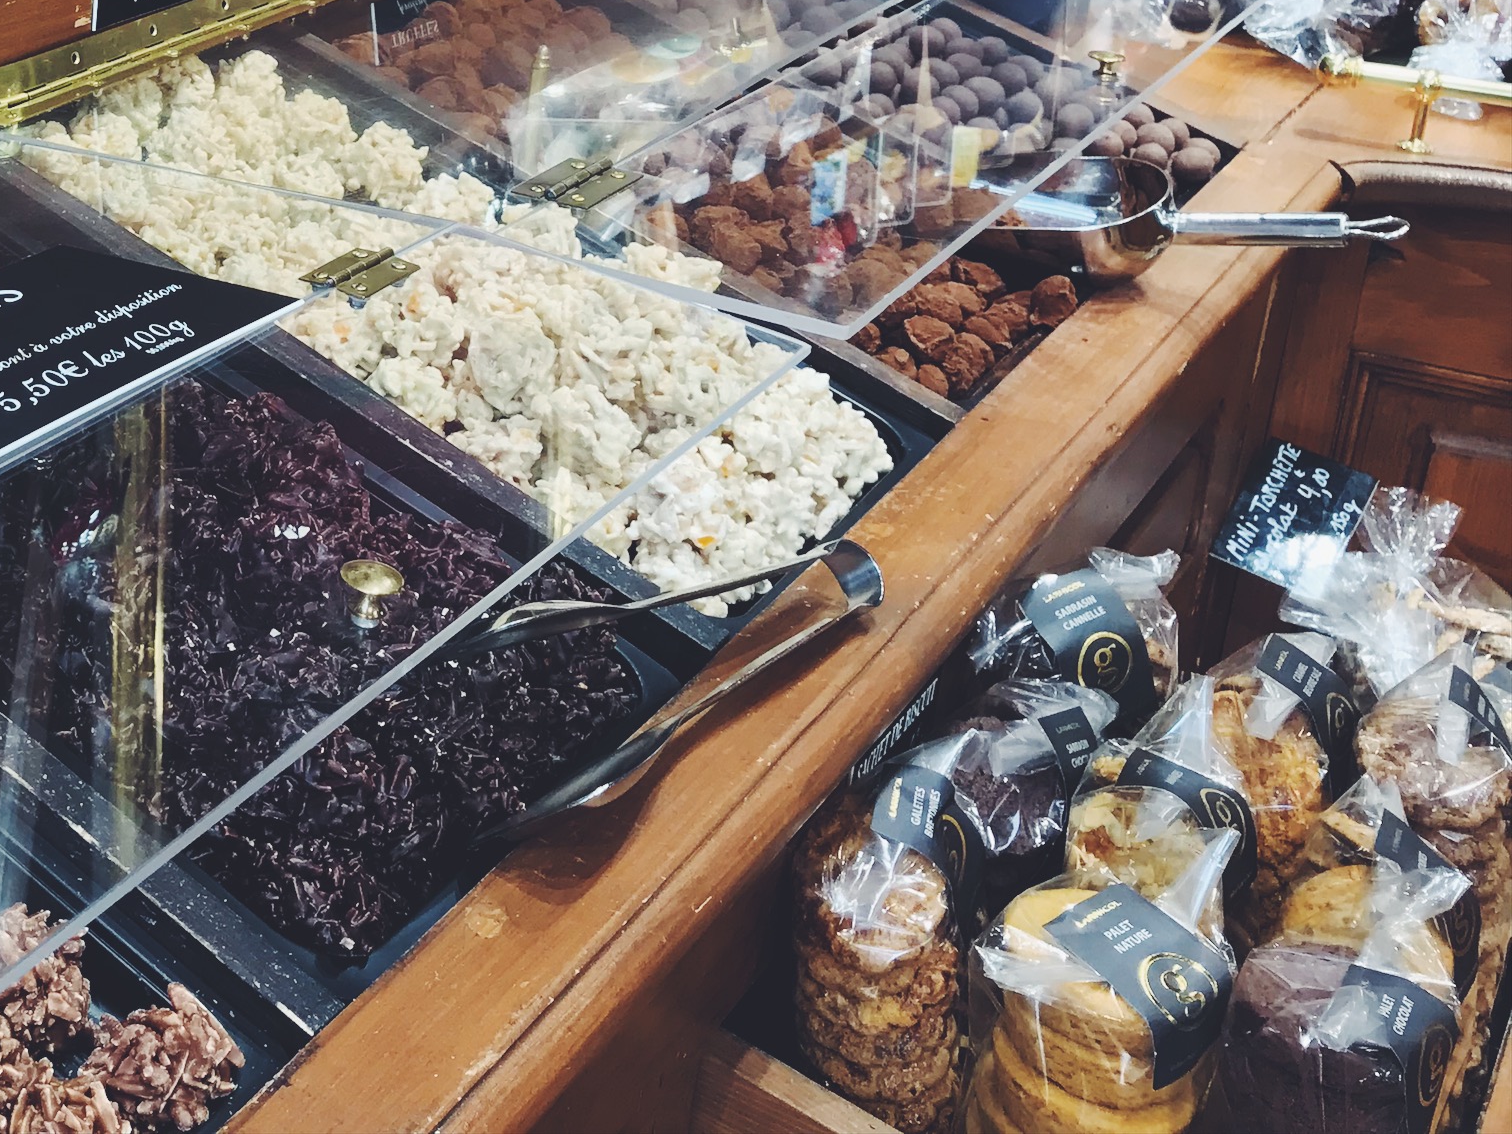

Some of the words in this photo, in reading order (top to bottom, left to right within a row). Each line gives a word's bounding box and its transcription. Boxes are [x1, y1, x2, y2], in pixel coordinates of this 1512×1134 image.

[29, 341, 48, 353] à
[49, 319, 97, 346] votre
[97, 282, 183, 324] disposition
[83, 348, 126, 368] les
[124, 318, 195, 352] 100g
[1042, 580, 1086, 604] LARNICOL
[1054, 594, 1098, 619] SARRASIN
[1062, 606, 1107, 631] CANNELLE
[910, 785, 925, 826] GALETTES
[1075, 900, 1123, 929] LARNICOL
[1104, 919, 1134, 941] PALET
[1113, 928, 1153, 954] NATURE
[1377, 993, 1396, 1018] PALET
[1392, 995, 1415, 1036] CHOCOLAT
